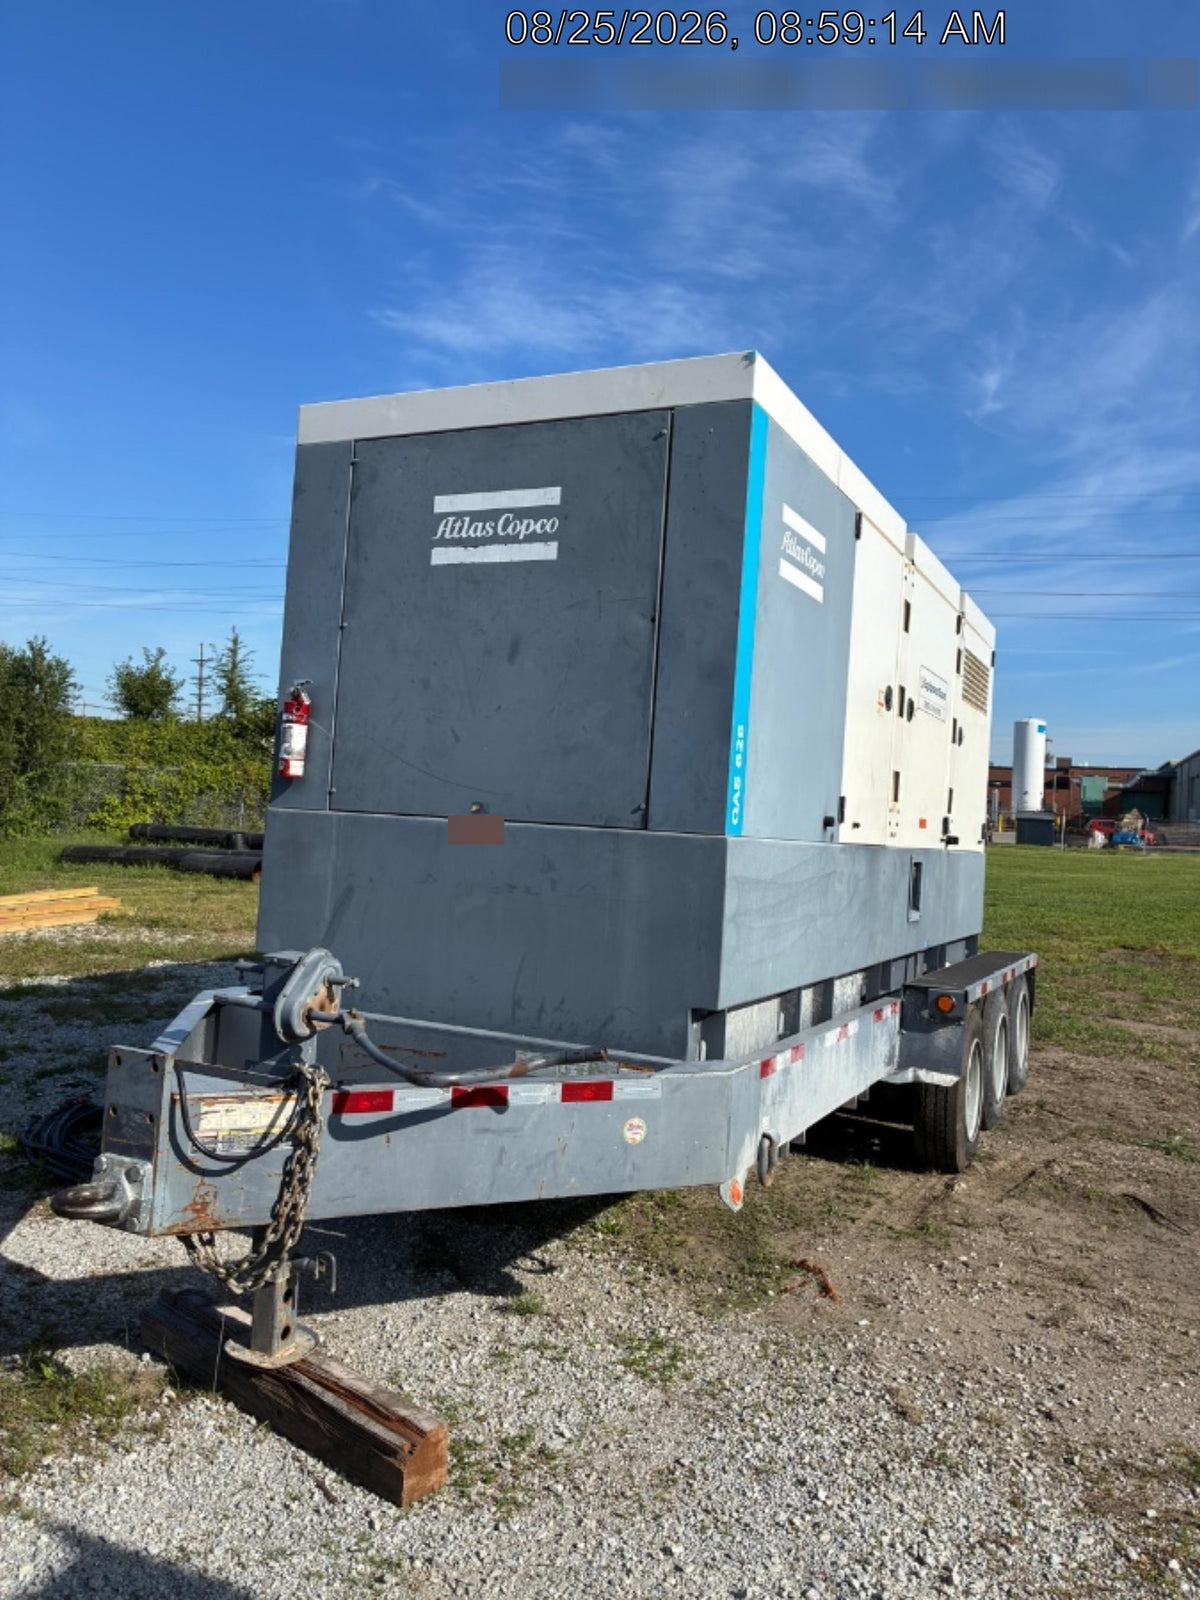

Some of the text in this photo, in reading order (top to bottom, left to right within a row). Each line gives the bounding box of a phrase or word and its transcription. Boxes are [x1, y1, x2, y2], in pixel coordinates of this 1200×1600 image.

[432, 513, 559, 540] Atlas Copco
[731, 776, 742, 826] QAS
